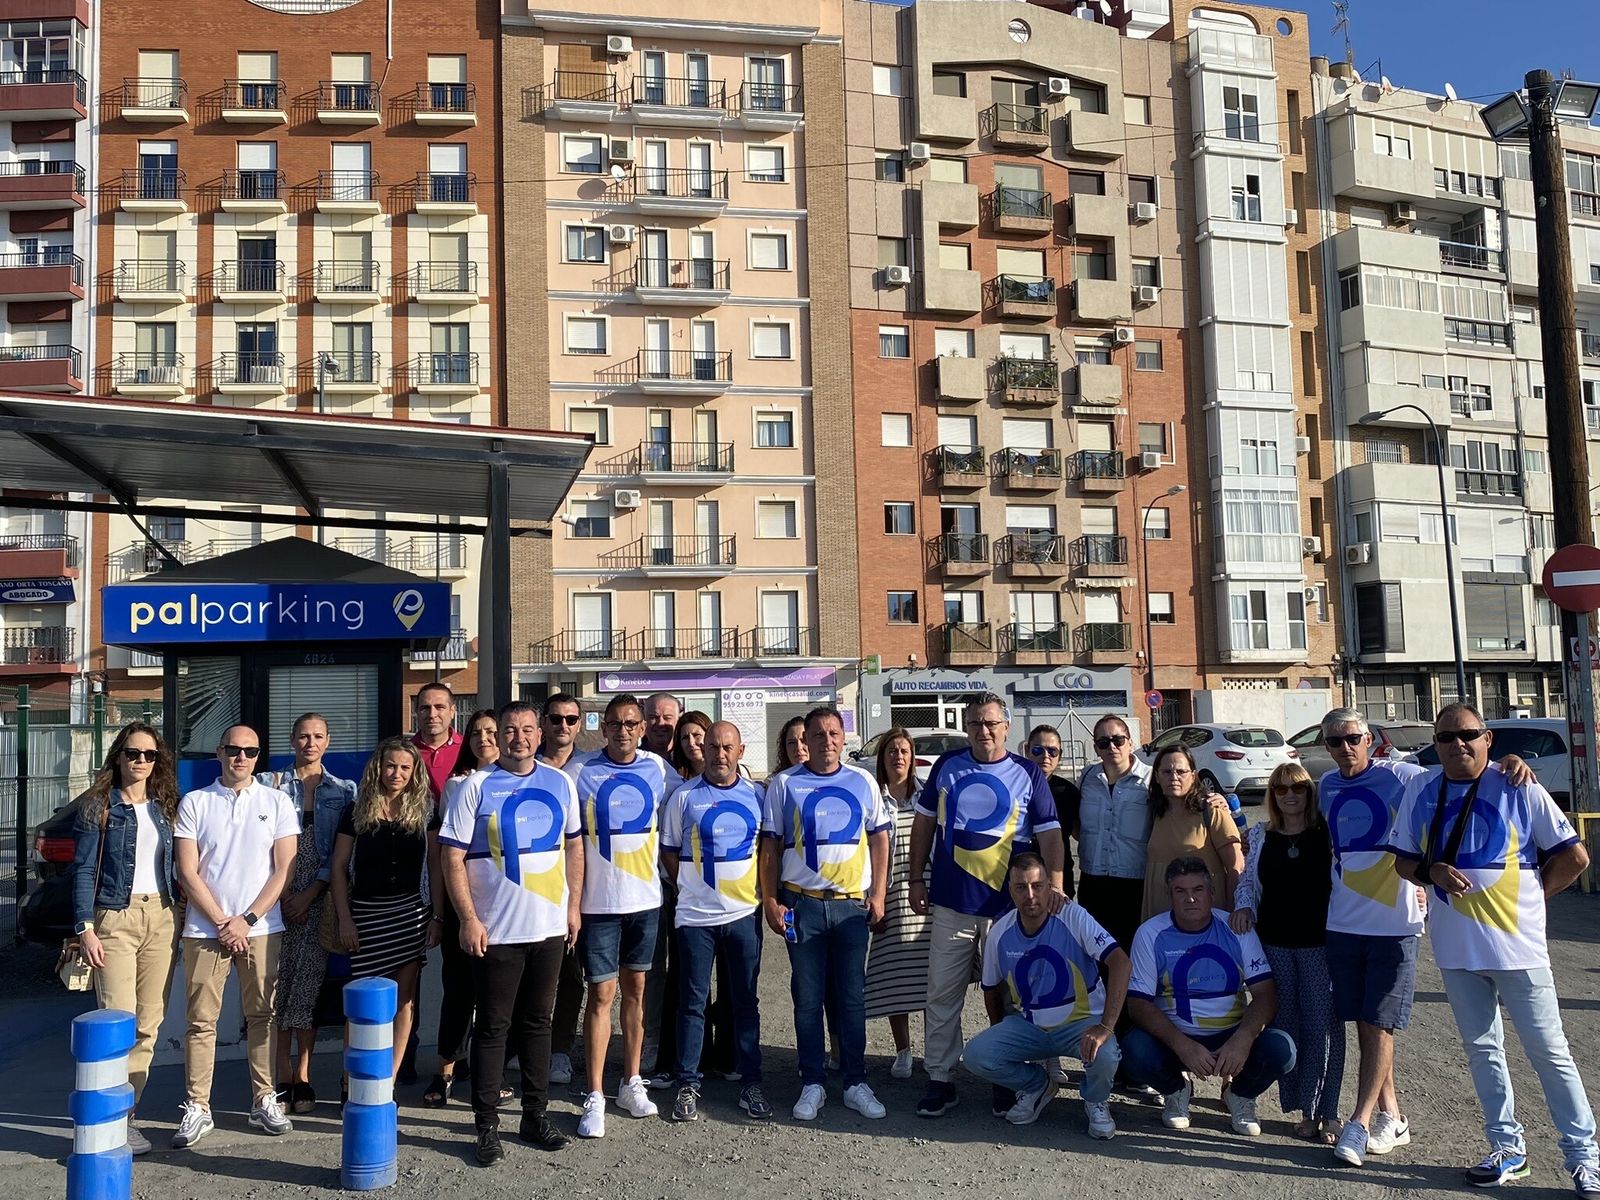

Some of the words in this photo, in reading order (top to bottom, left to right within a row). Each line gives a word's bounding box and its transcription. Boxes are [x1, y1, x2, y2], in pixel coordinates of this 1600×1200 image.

[130, 592, 364, 634] palparking
[894, 681, 917, 691] AUTO
[918, 681, 966, 690] RECAMBIOS
[968, 680, 988, 690] VIDA
